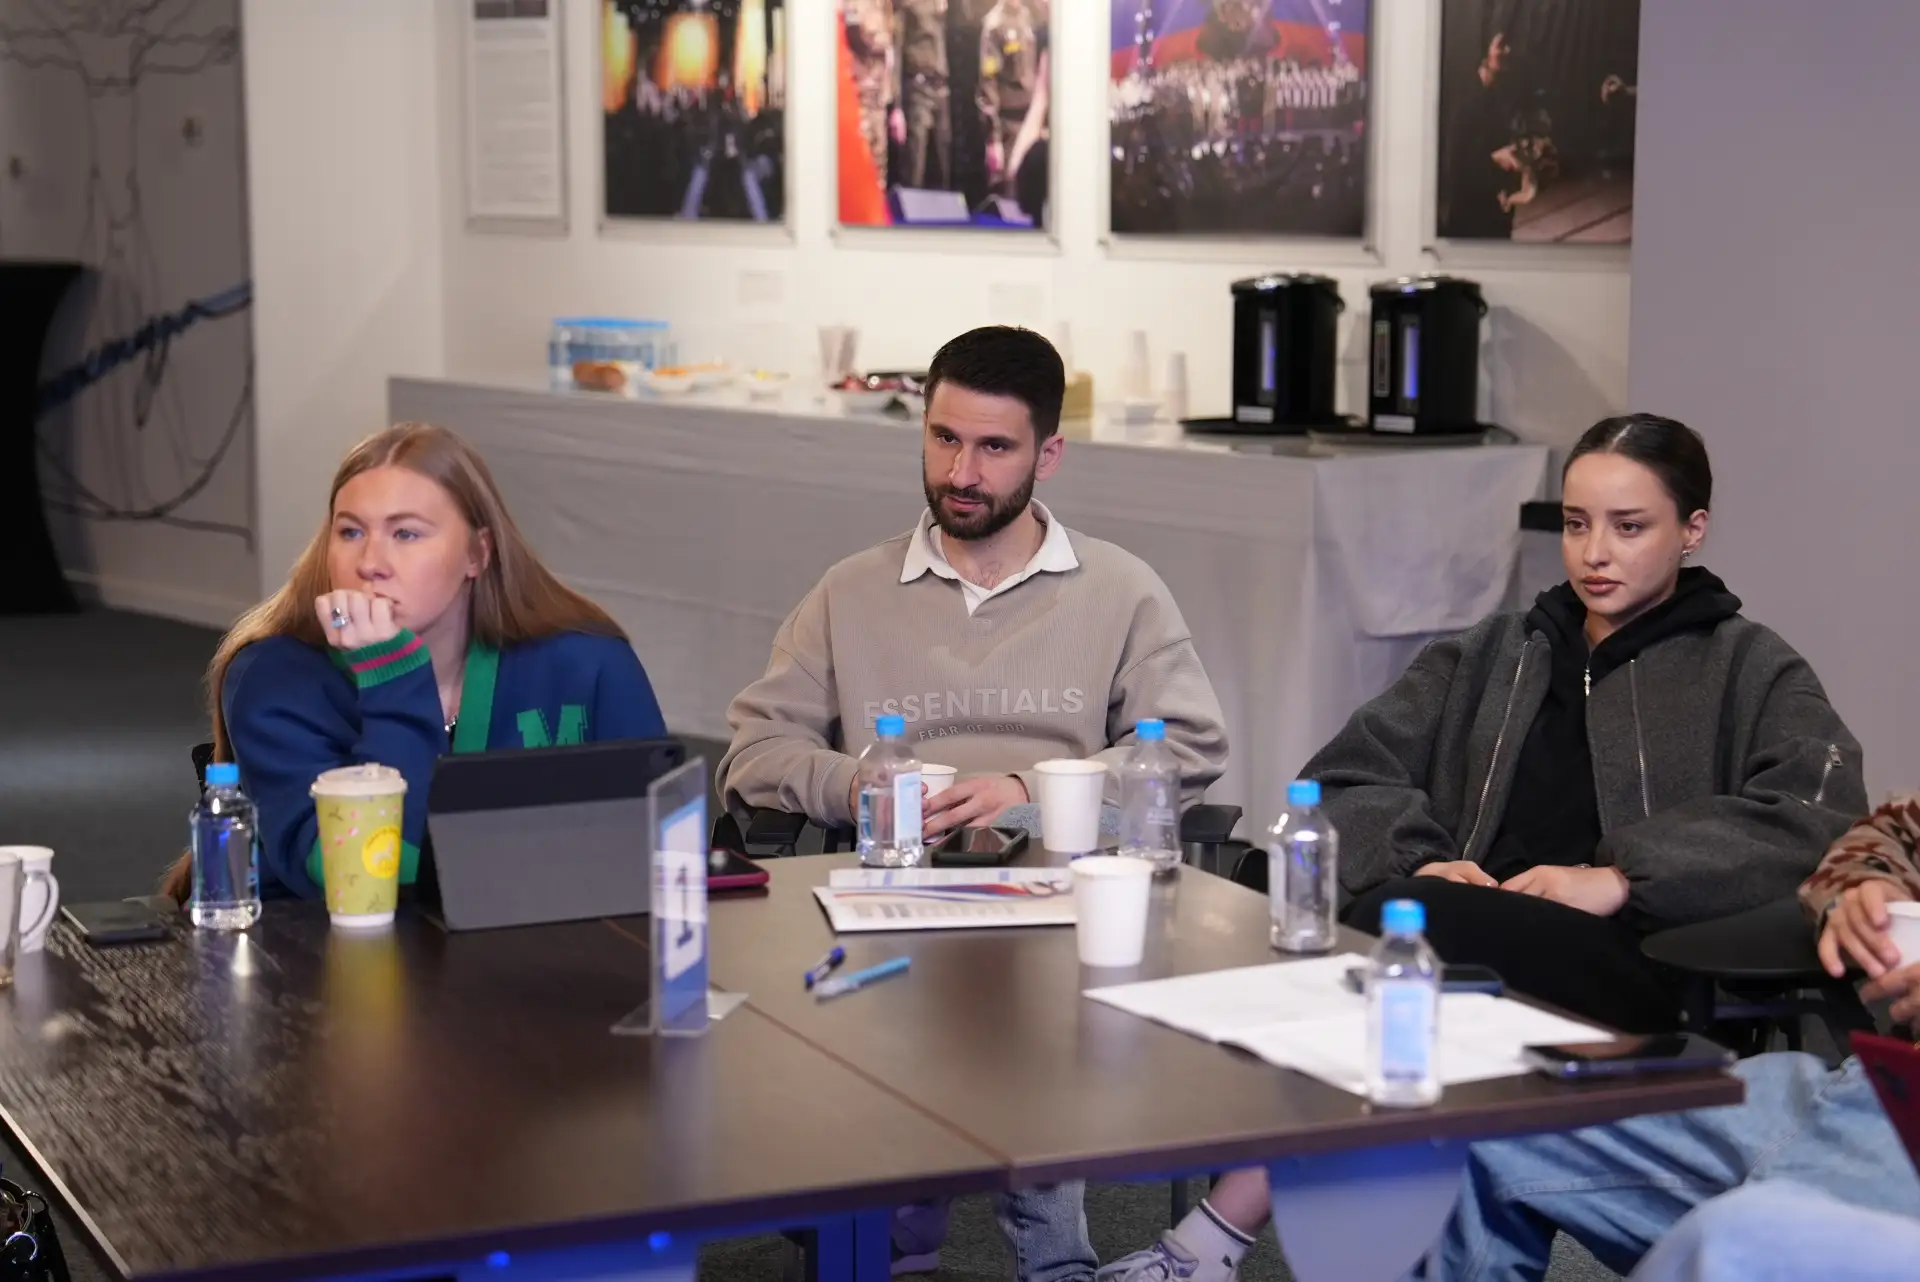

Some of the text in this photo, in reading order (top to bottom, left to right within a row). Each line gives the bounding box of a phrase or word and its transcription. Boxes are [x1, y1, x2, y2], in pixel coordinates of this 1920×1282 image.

[864, 687, 1084, 729] ESSENTIALS
[918, 723, 1025, 741] FEAR OF GOD
